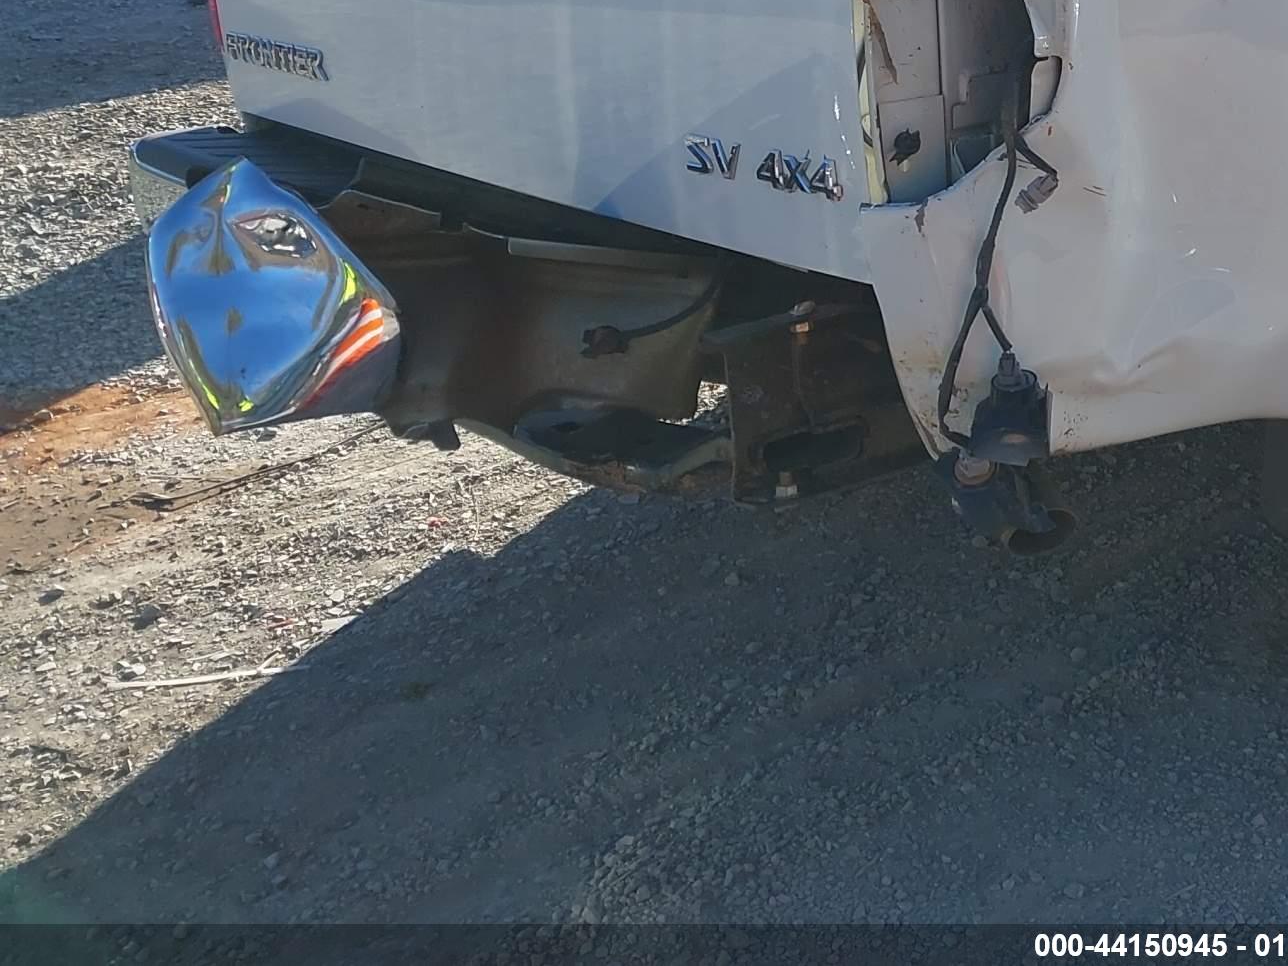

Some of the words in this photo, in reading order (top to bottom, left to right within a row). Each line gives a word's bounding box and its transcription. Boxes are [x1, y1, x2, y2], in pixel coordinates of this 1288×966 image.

[225, 31, 329, 81] FRONTIER
[684, 134, 741, 180] SV
[757, 149, 843, 202] 4X4
